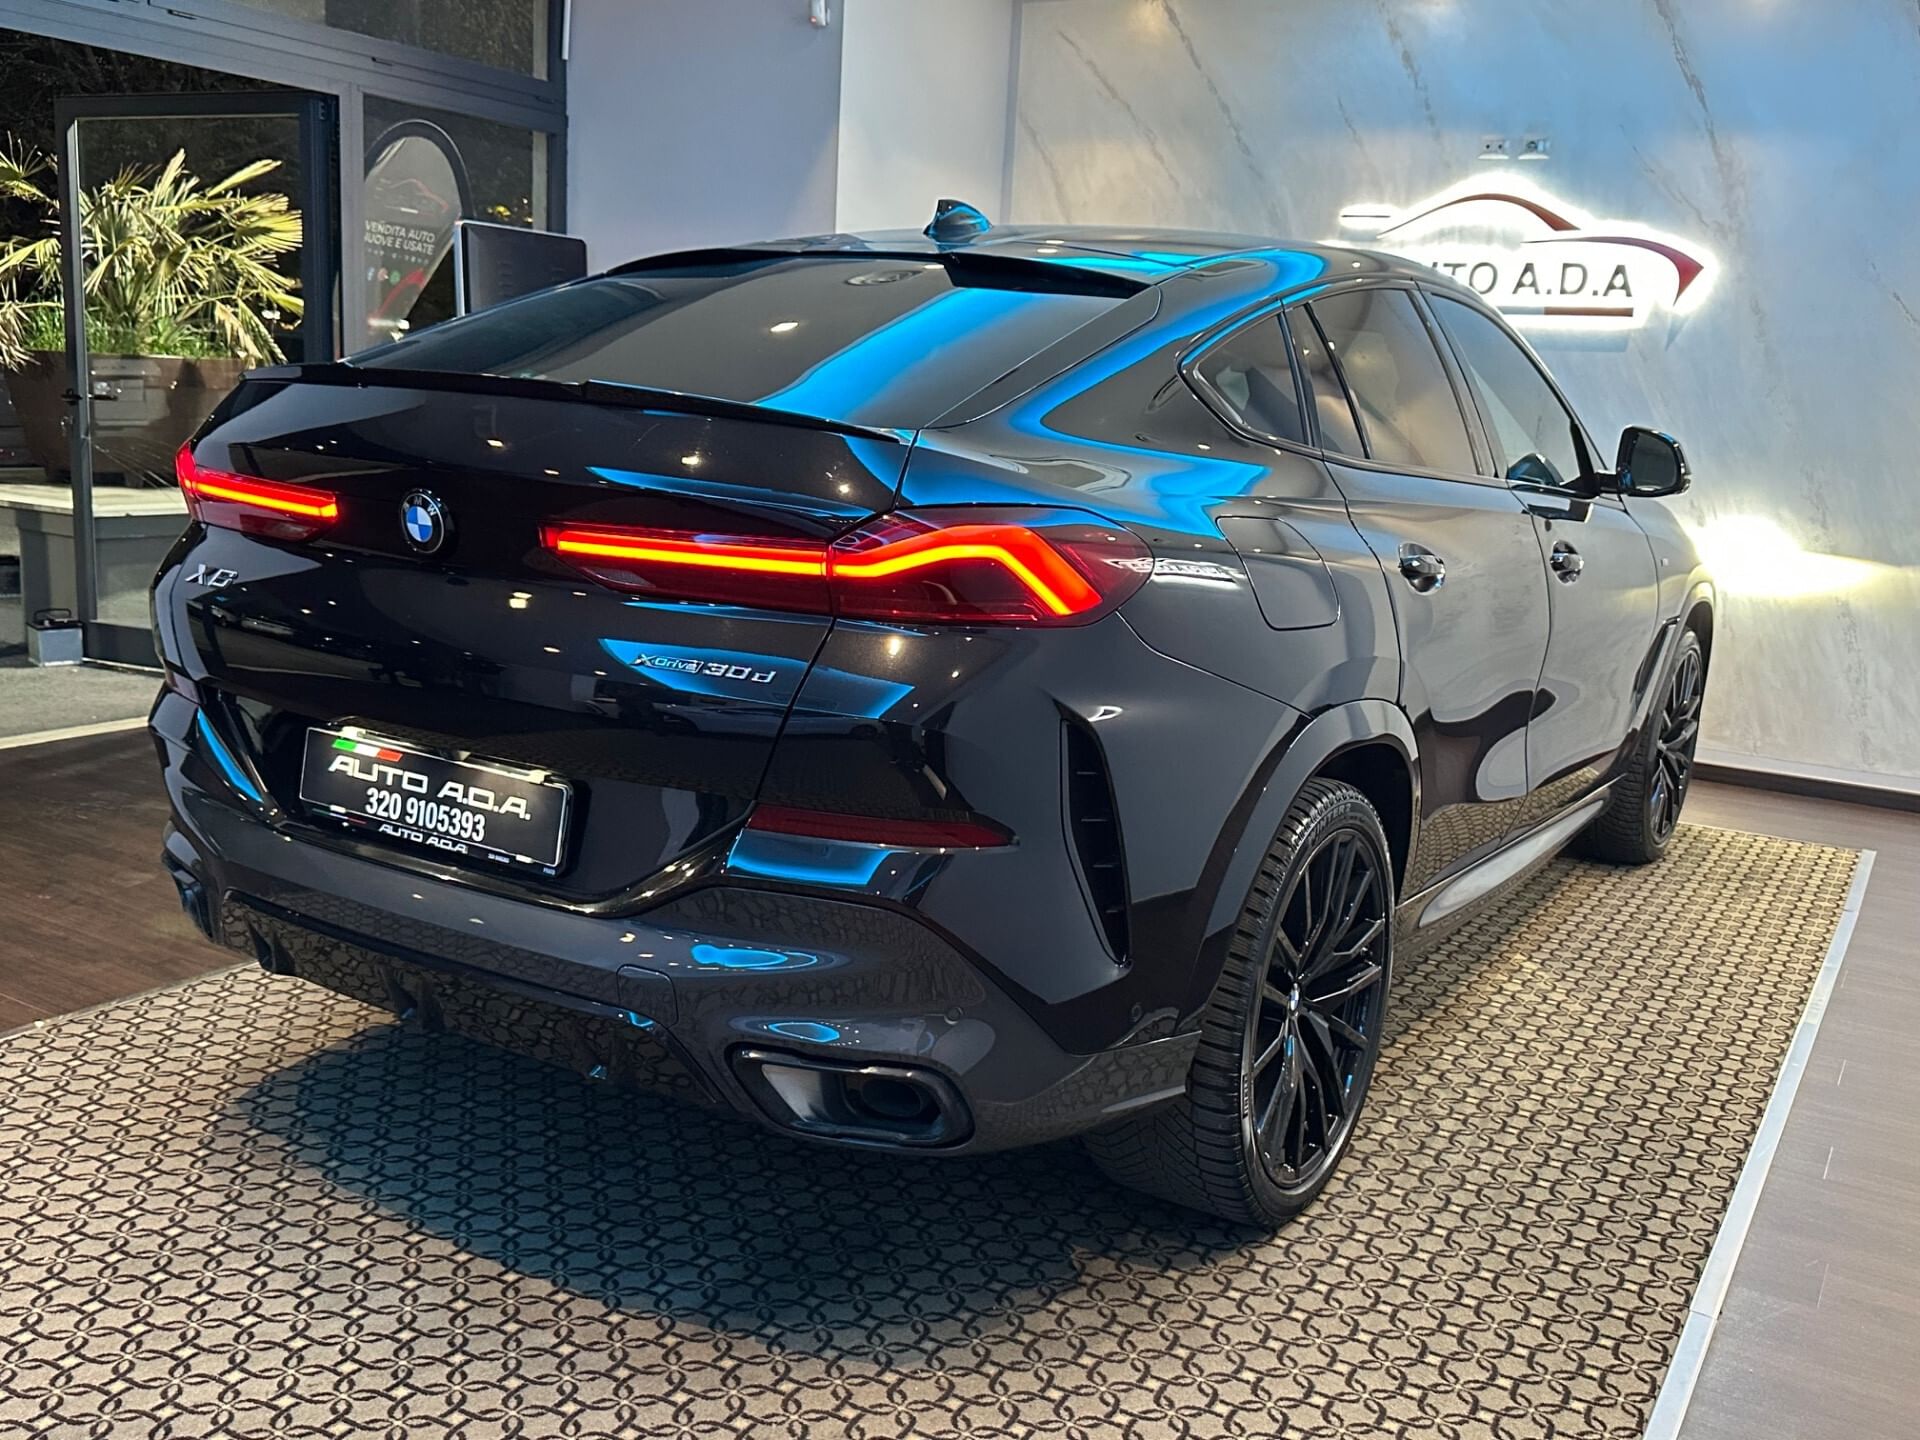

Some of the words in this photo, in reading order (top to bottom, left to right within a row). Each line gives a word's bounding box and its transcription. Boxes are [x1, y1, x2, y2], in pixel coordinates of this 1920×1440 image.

[403, 239, 435, 255] USATE
[408, 230, 435, 242] AUTO
[185, 563, 238, 587] X6
[328, 755, 428, 794] AUTO
[437, 780, 531, 820] A.D.A.
[365, 787, 401, 820] 320
[405, 798, 486, 842] 9105393
[378, 823, 423, 843] AUTO
